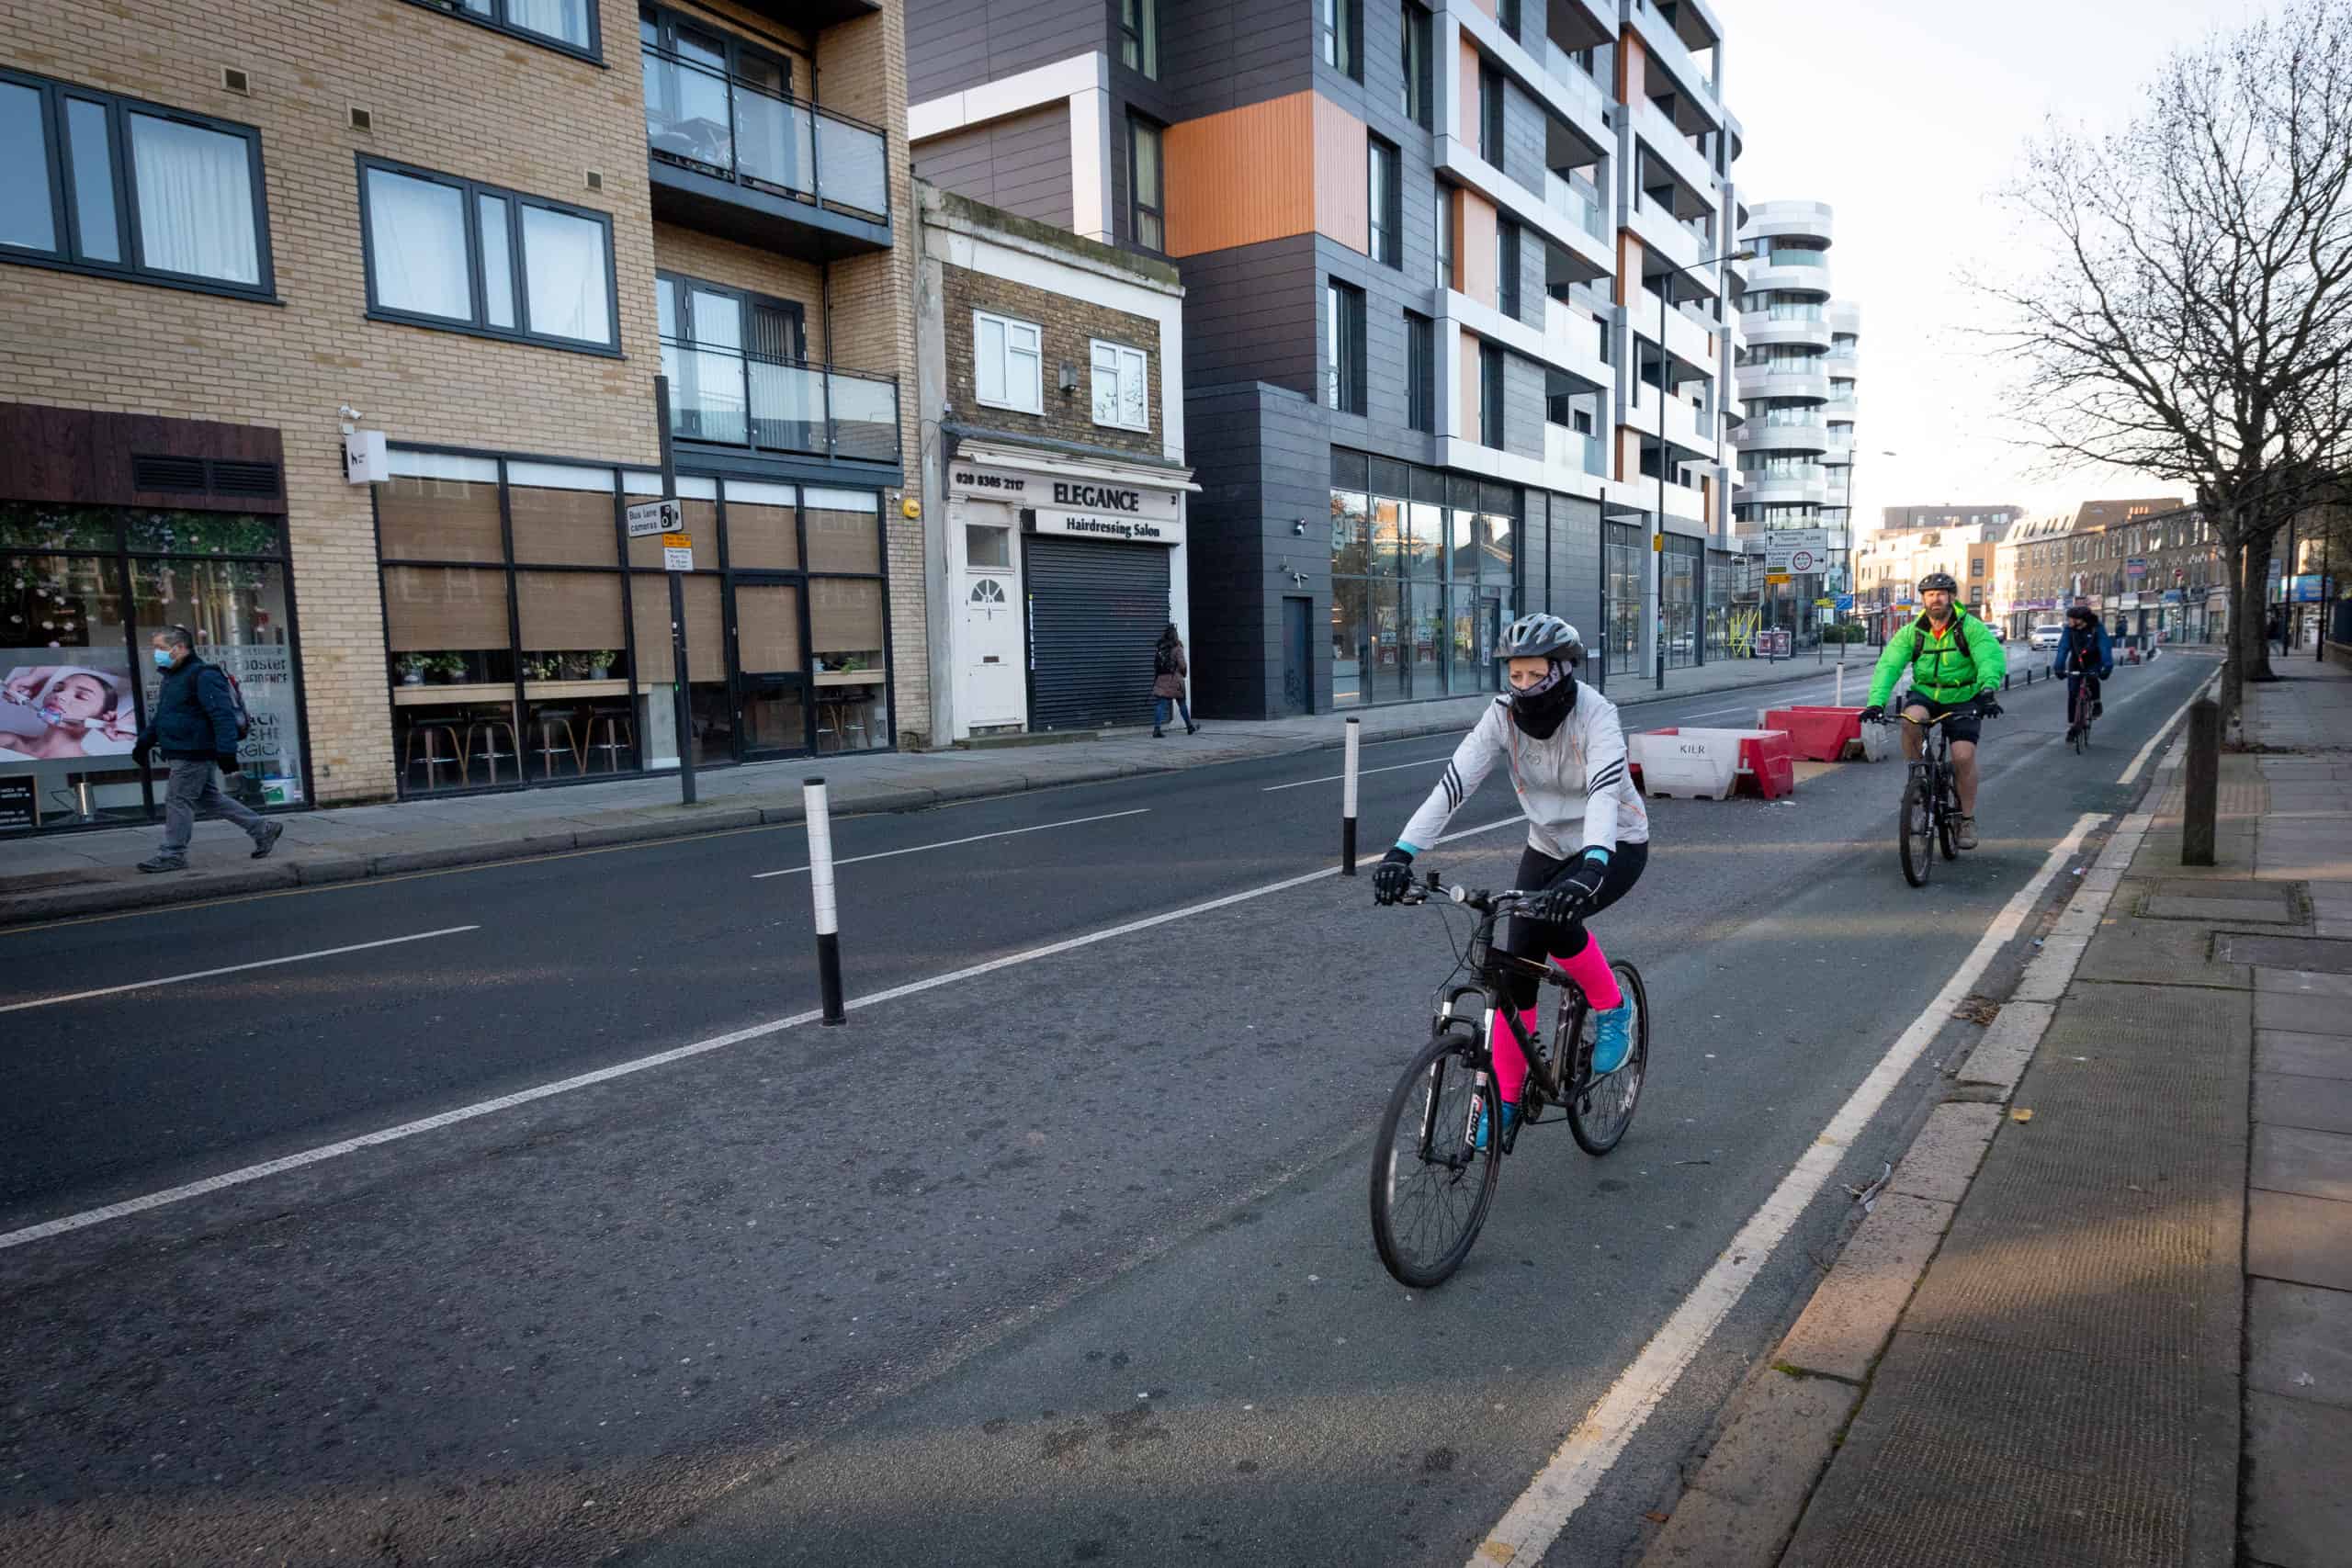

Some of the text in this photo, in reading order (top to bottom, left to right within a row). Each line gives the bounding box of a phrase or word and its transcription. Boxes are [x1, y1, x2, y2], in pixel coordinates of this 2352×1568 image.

[956, 472, 974, 485] 020
[1054, 482, 1139, 513] ELEGANCE
[1067, 517, 1160, 537] Hairdressing Salon
[1680, 745, 1705, 754] KILR
